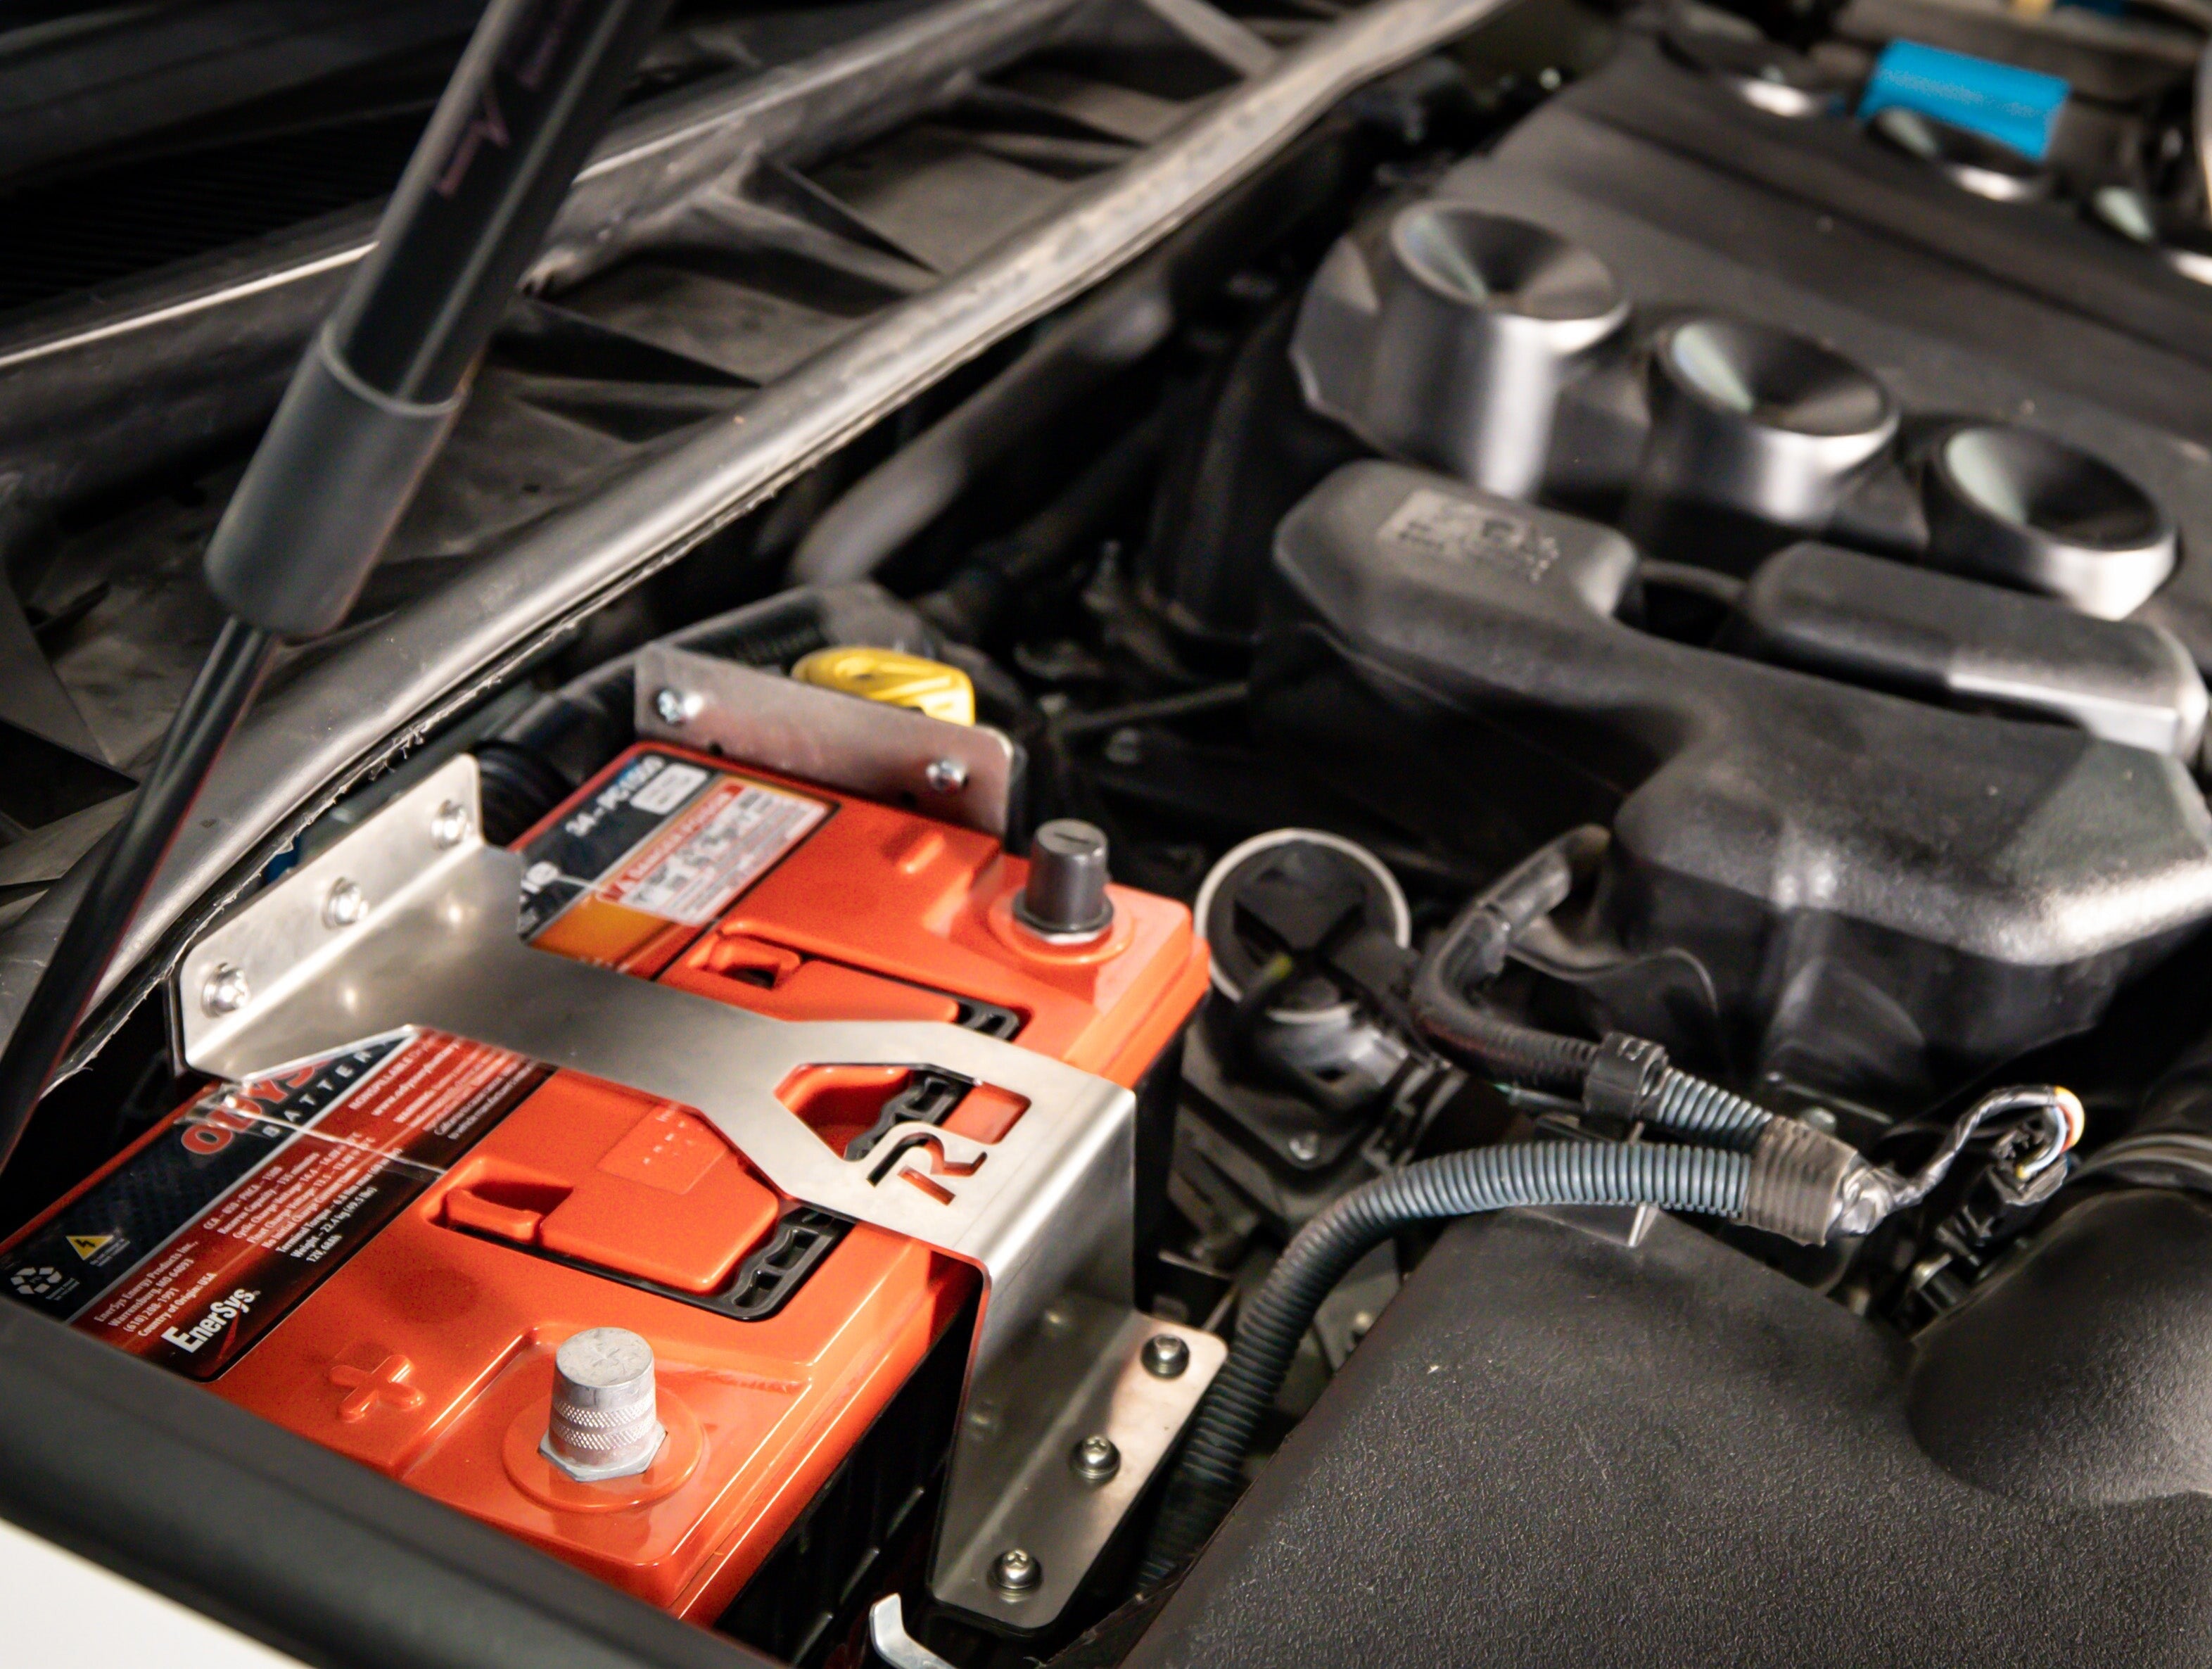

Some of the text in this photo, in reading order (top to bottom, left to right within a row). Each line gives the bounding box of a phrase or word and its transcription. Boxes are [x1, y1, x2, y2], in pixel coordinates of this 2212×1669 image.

[181, 1058, 336, 1154] ODYS
[262, 1045, 383, 1137] BATTER
[276, 1227, 310, 1252] Terminal
[304, 1208, 333, 1228] Torque
[291, 1236, 322, 1258] Weight
[320, 1219, 341, 1232] 22.4
[94, 1297, 129, 1322] EnerSys
[122, 1277, 154, 1300] Energy
[146, 1252, 182, 1278] Products
[108, 1286, 163, 1328] Warrensburg,
[156, 1276, 173, 1287] MO
[137, 1312, 172, 1338] Country
[174, 1285, 205, 1307] Origin:
[198, 1273, 217, 1285] USA
